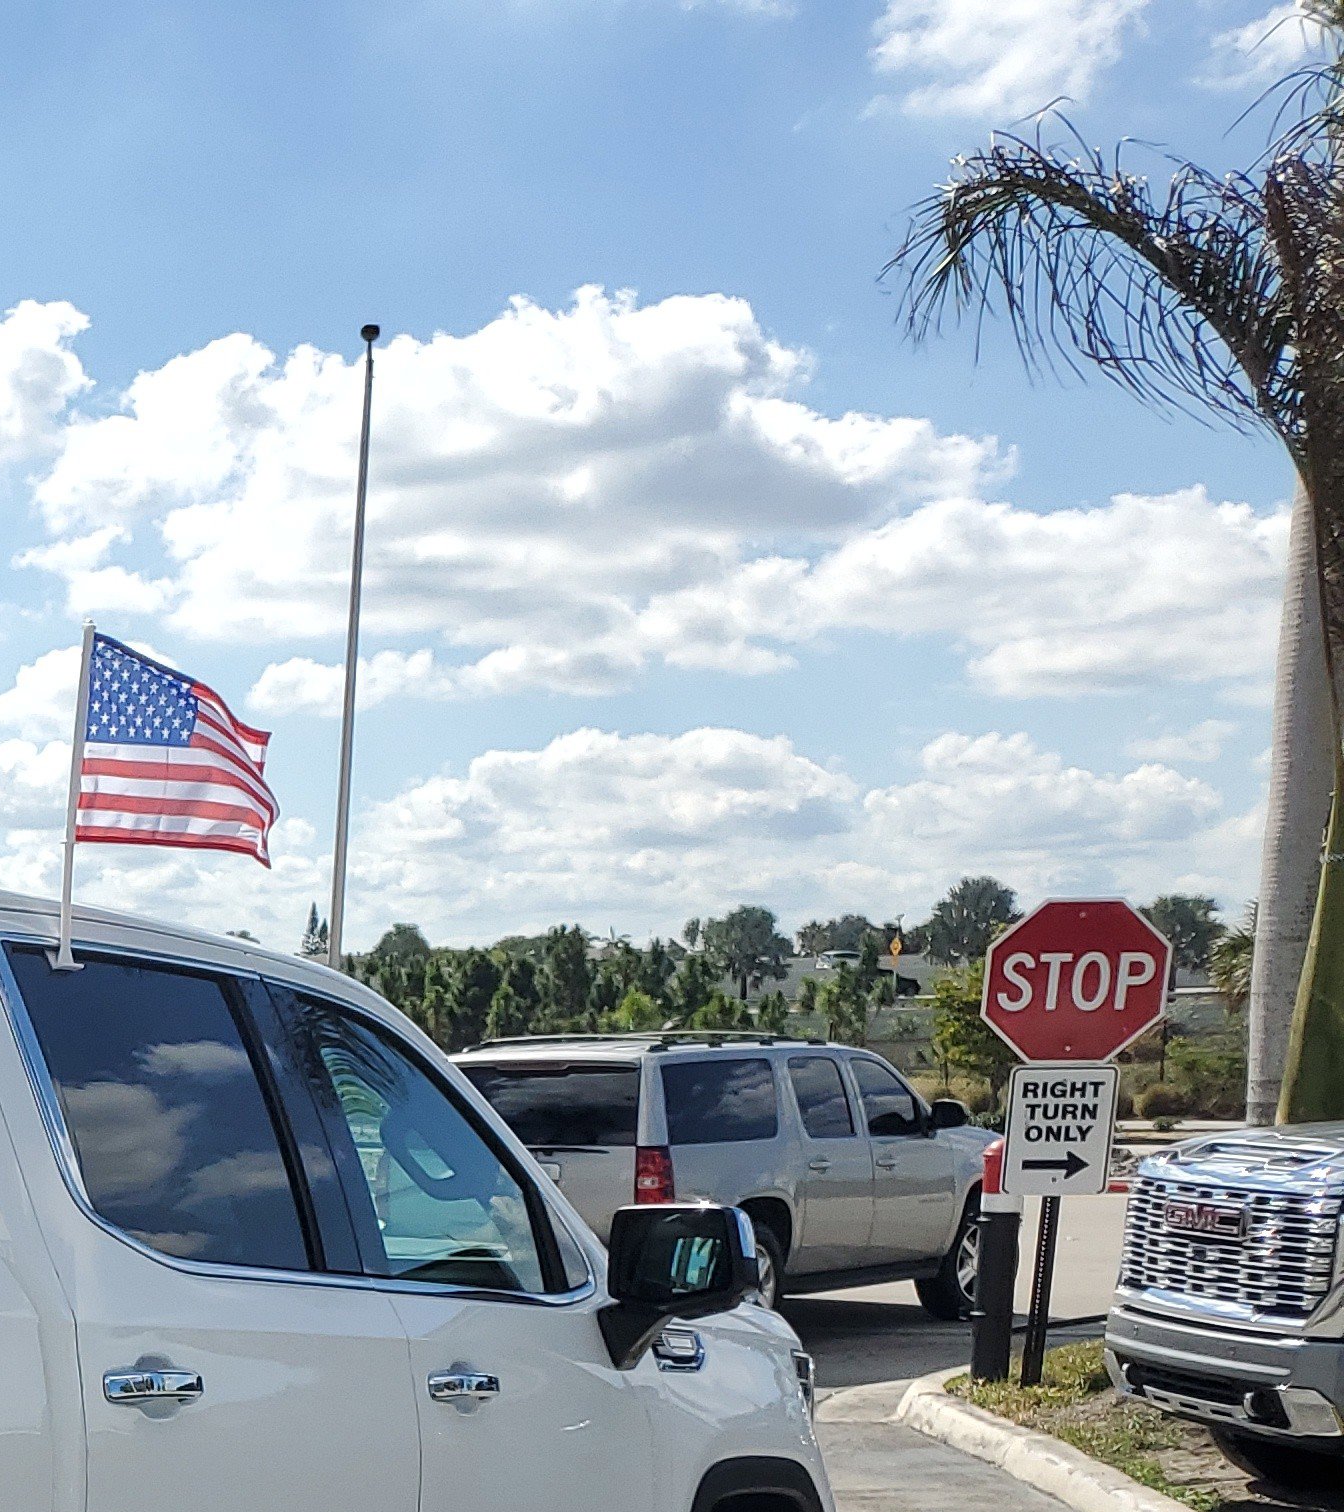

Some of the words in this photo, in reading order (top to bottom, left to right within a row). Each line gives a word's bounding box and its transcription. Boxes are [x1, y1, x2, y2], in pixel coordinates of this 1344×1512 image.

[996, 951, 1156, 1012] STOP
[1021, 1080, 1106, 1099] RIGHT
[1025, 1103, 1099, 1121] TURN
[1024, 1124, 1094, 1143] ONLY
[1166, 1202, 1240, 1235] GMC
